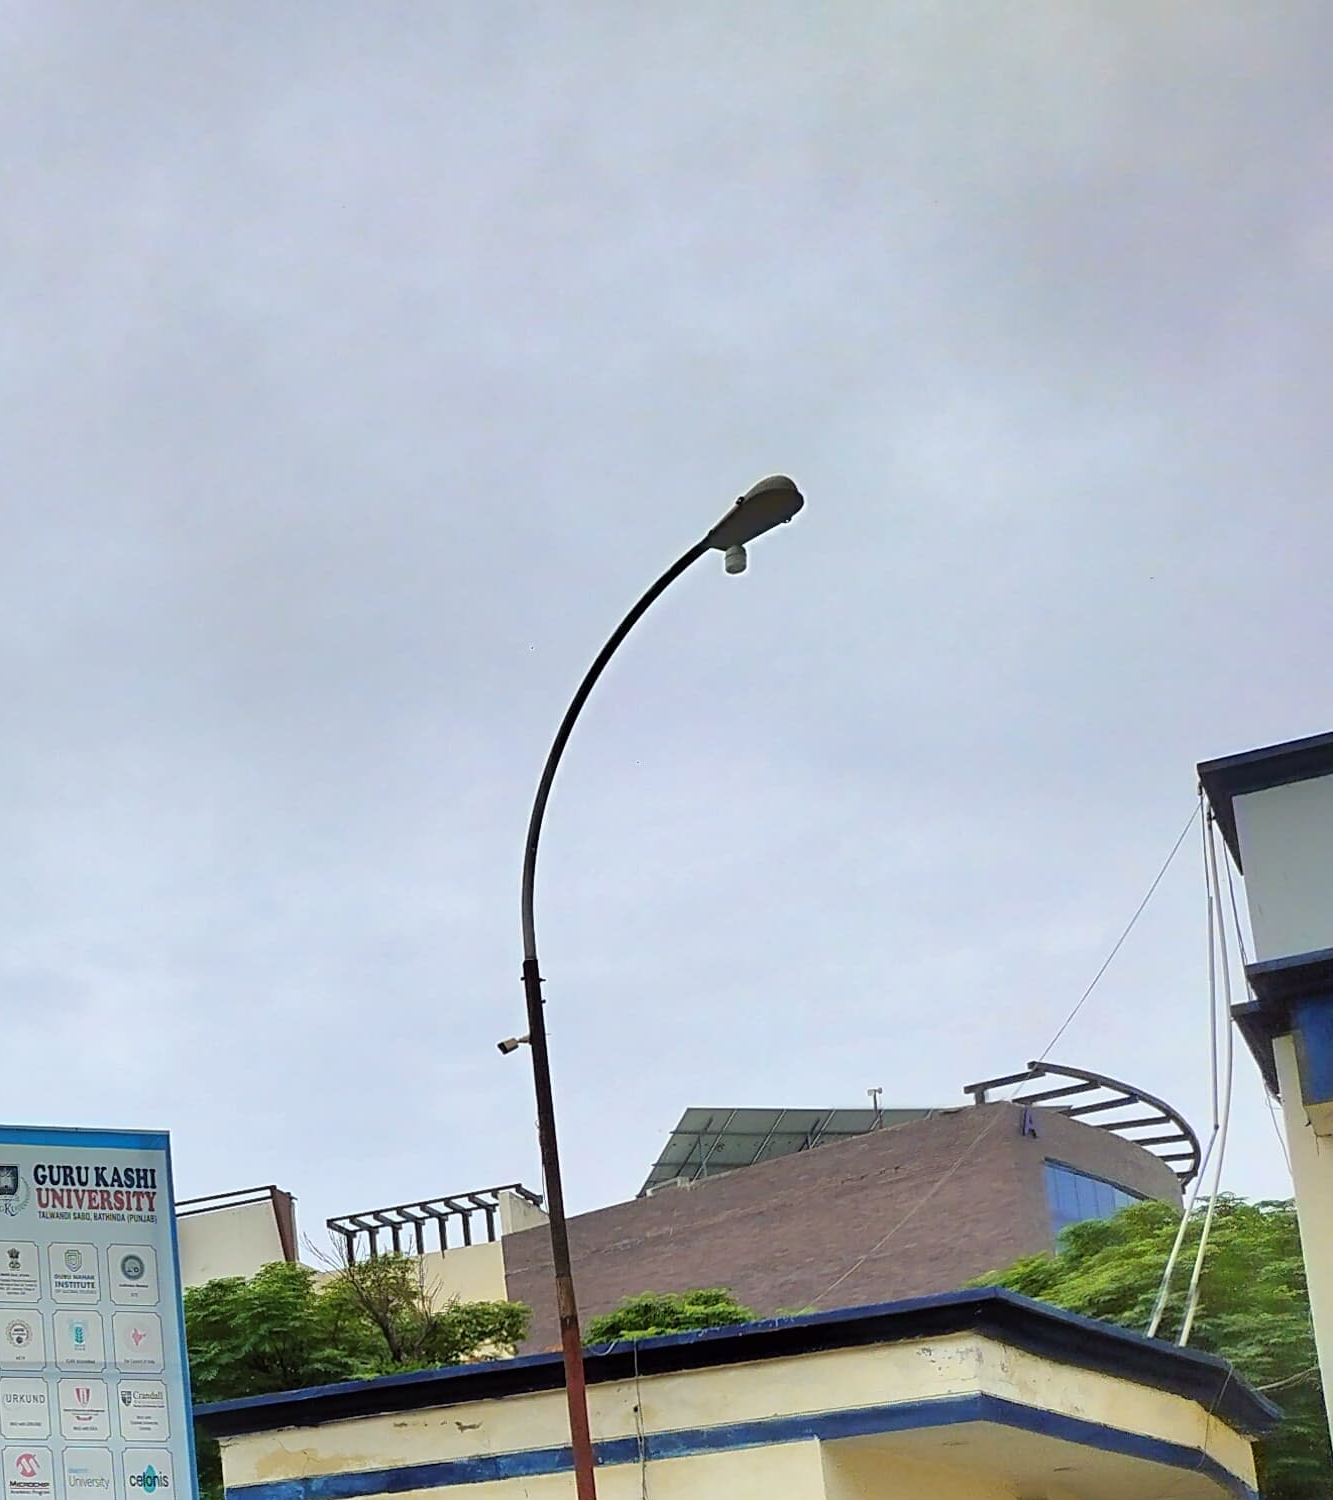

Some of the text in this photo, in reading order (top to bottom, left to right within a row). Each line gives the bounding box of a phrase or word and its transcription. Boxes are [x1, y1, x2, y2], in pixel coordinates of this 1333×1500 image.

[33, 1164, 157, 1189] GURU KASHI
[36, 1187, 157, 1212] UNIVERSITY
[54, 1280, 96, 1289] INSTITUTE
[5, 1393, 46, 1404] URKUND
[68, 1475, 110, 1490] University
[129, 1472, 170, 1488] celonis
